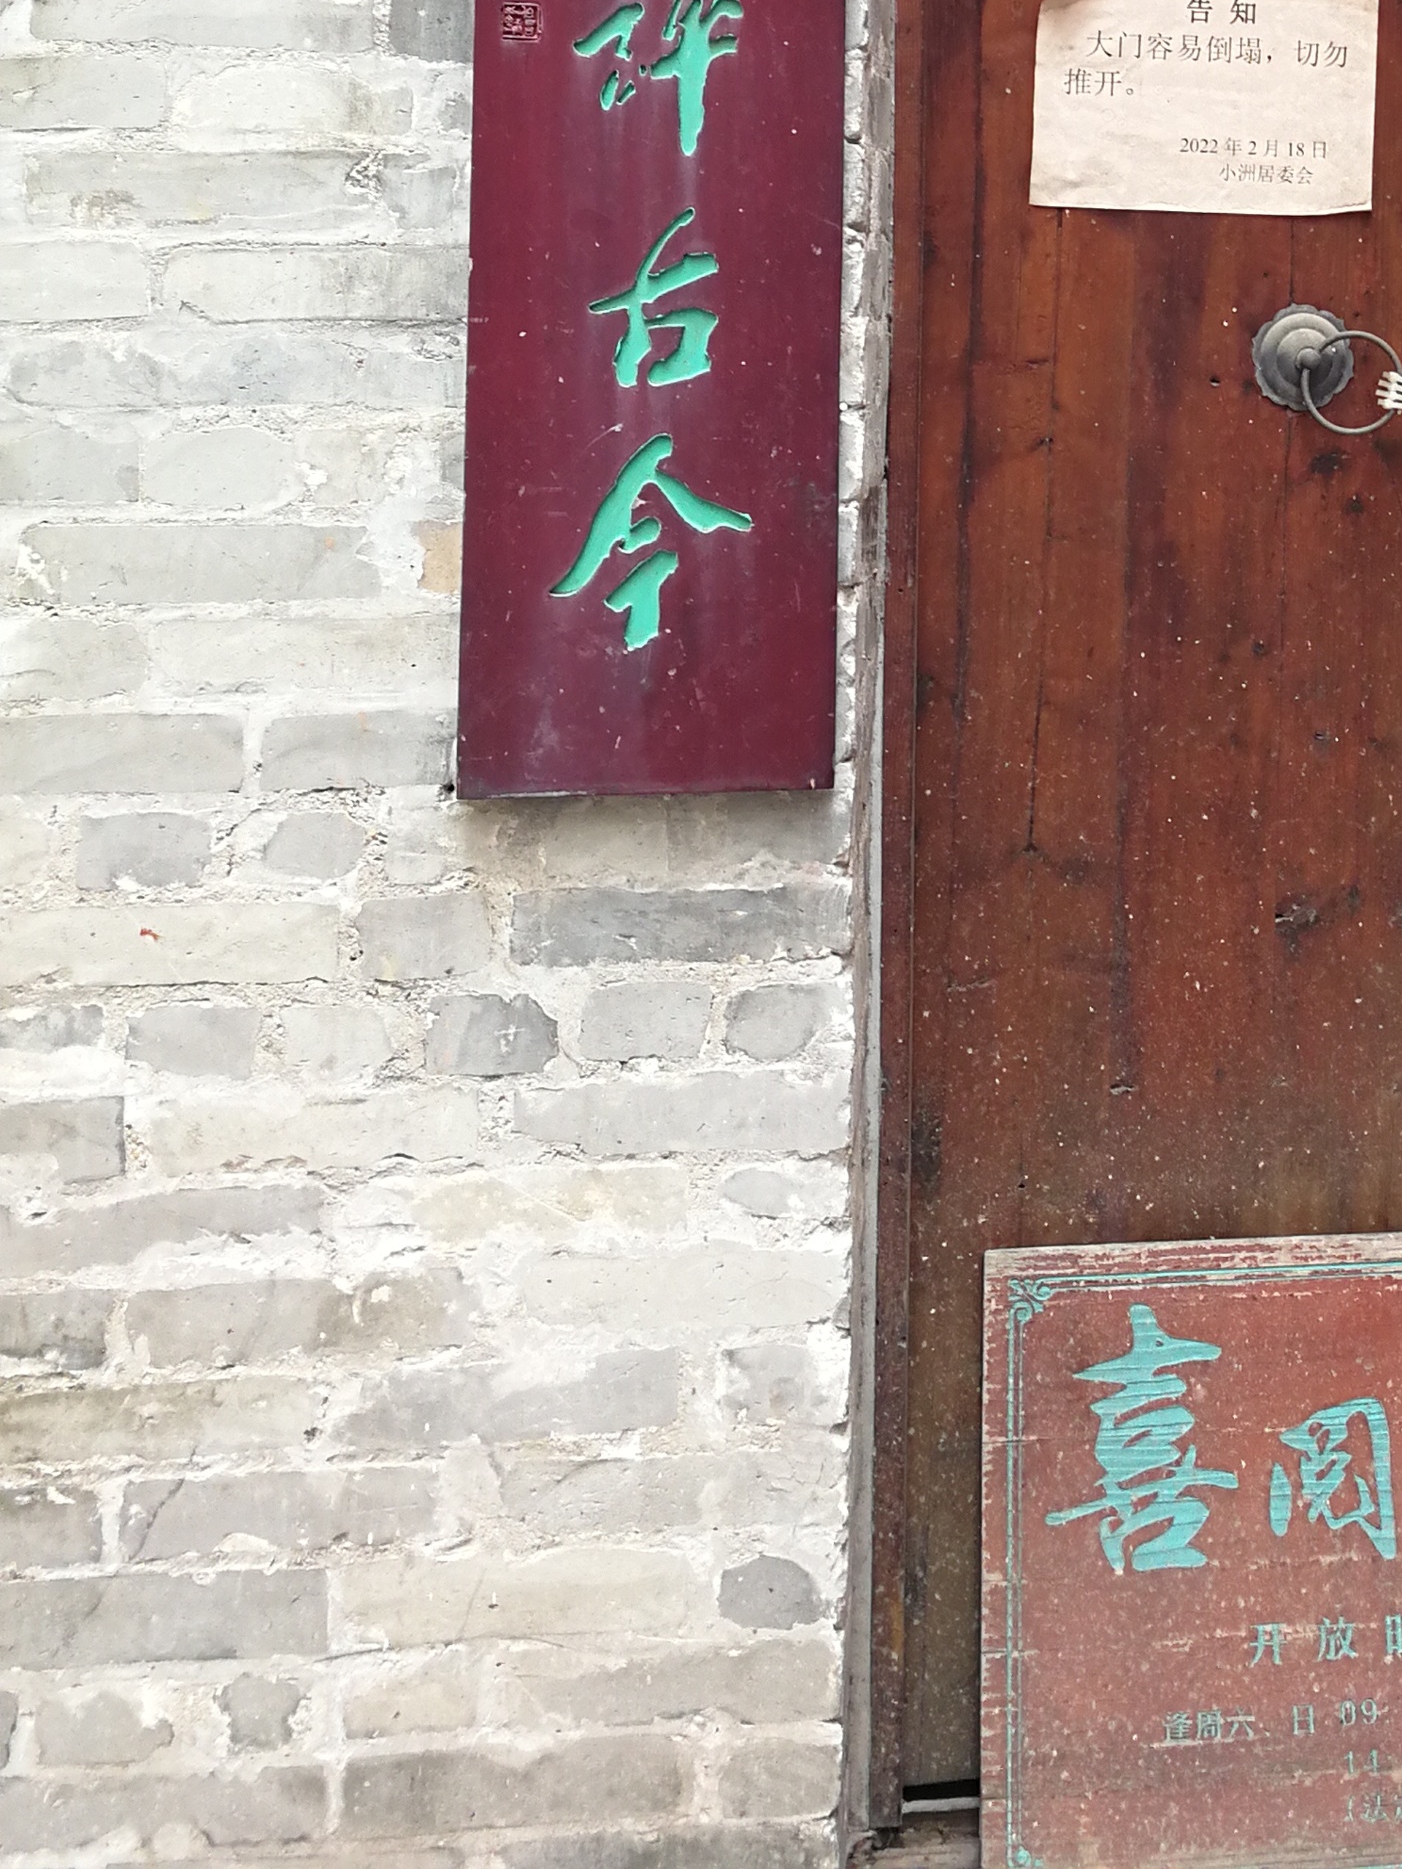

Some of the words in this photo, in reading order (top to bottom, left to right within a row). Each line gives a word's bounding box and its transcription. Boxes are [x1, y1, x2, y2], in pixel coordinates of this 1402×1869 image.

[1085, 29, 1349, 69] 大门容易倒塌，切勿
[1063, 68, 1137, 97] 推开。
[1178, 136, 1328, 160] 2022年2月18日
[1218, 163, 1315, 186] 小洲居委会
